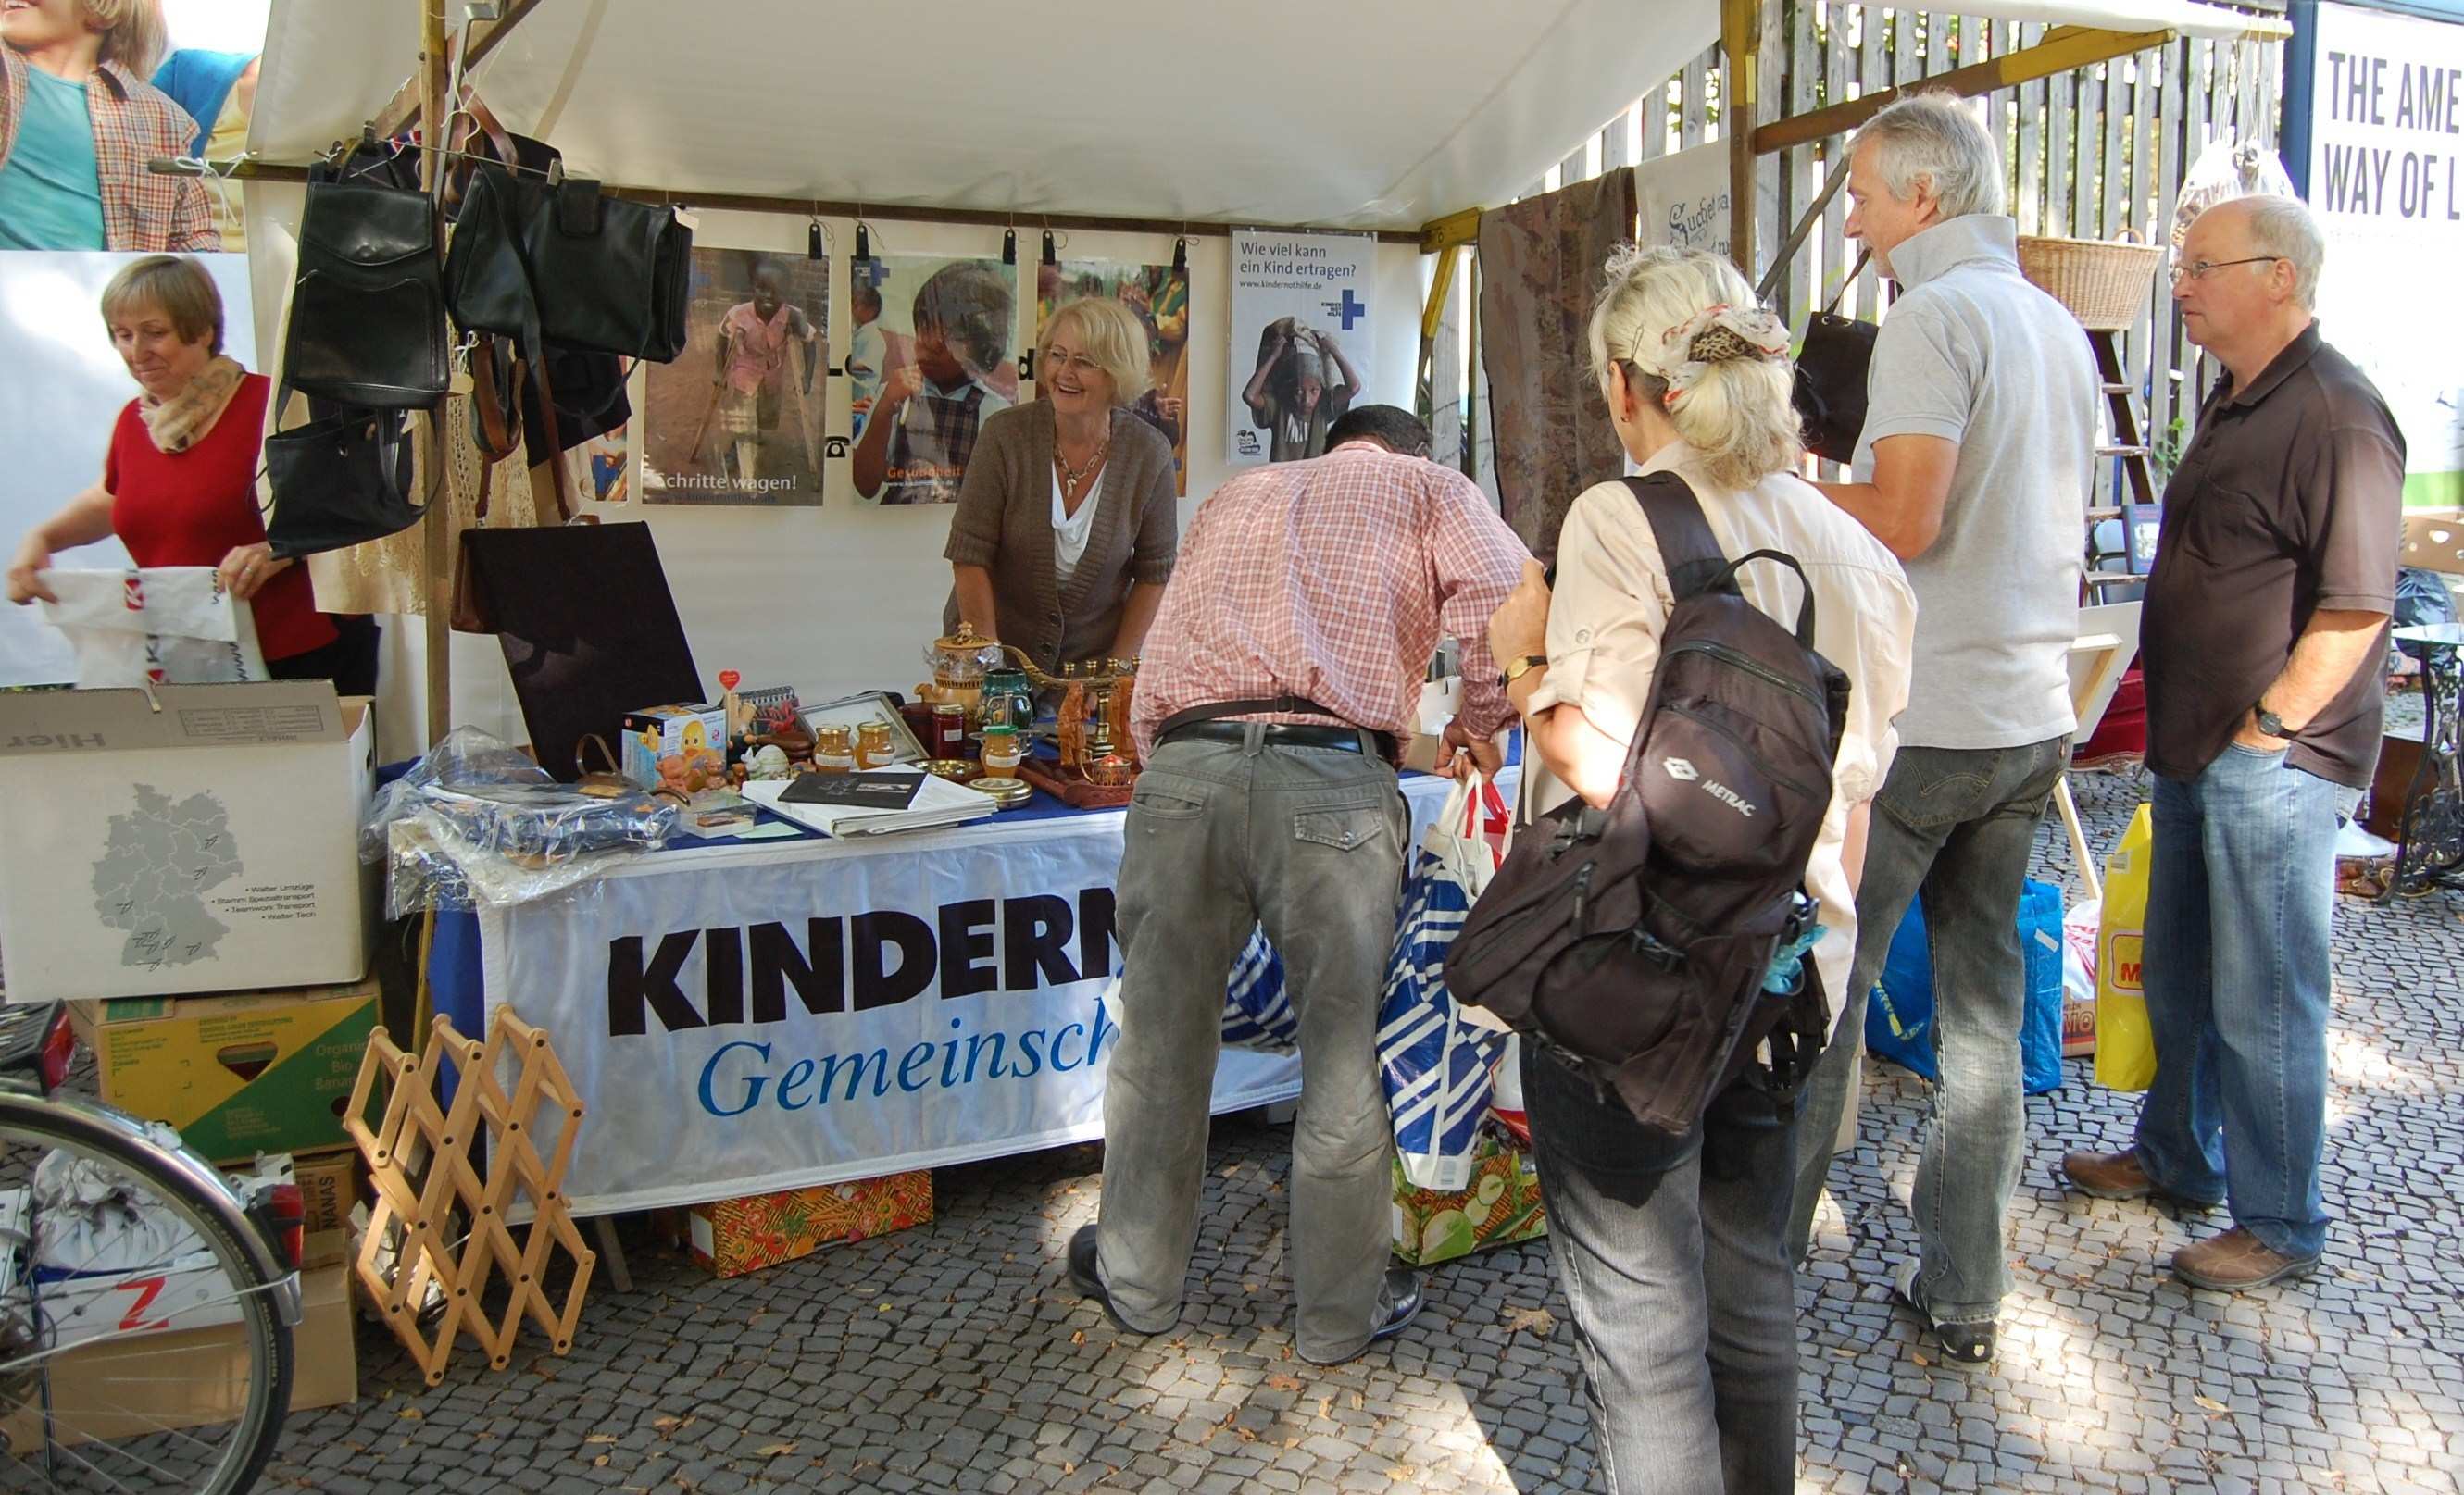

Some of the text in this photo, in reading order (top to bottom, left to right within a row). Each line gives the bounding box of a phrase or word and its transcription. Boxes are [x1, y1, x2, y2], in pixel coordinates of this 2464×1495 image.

[2328, 51, 2462, 134] THE AME
[2324, 143, 2392, 216] WAY
[2399, 151, 2438, 218] OF
[1240, 242, 1327, 258] Wie viel kann
[1240, 260, 1357, 280] ein Kind ertragen?
[1239, 280, 1323, 290] www.kindernothilfe.de
[657, 471, 797, 493] chritte wagen!
[1701, 779, 1757, 816] METRAC
